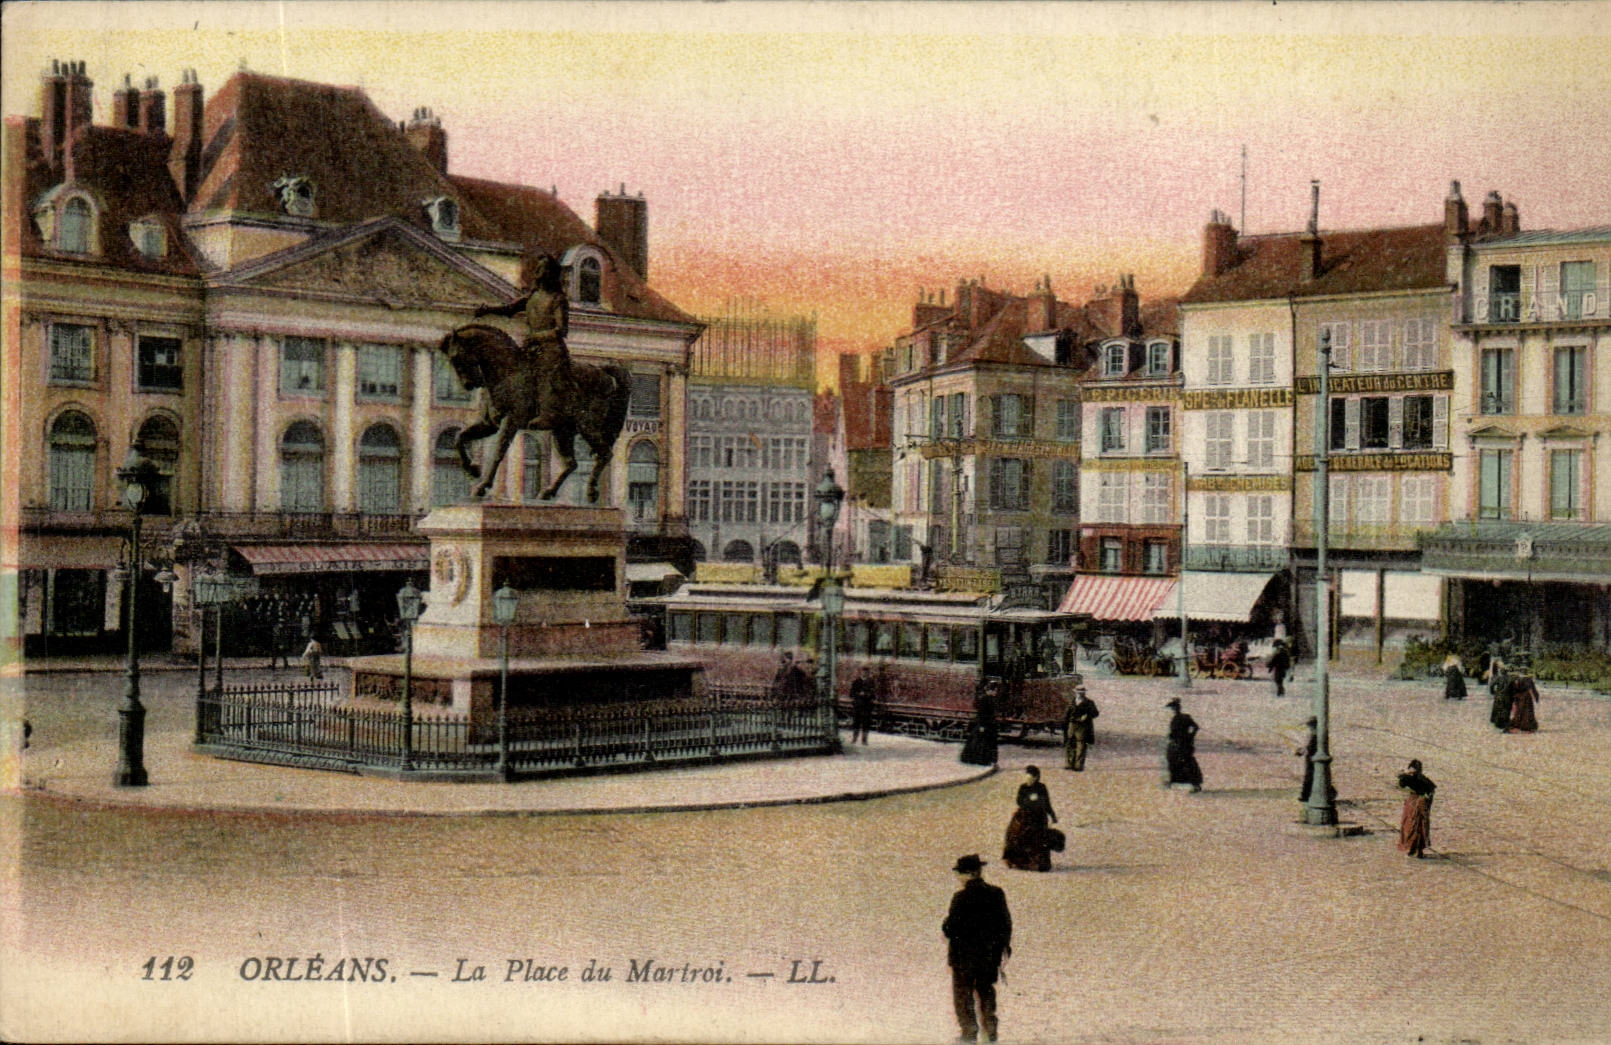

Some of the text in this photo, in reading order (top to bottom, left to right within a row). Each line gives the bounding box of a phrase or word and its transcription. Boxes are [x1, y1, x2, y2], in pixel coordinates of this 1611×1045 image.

[1474, 293, 1598, 322] GRAND
[1297, 375, 1382, 394] L'INICATEUR
[1395, 373, 1449, 390] CENTRE
[1226, 388, 1294, 409] FLANELLE
[1394, 453, 1450, 469] LOCATIONS
